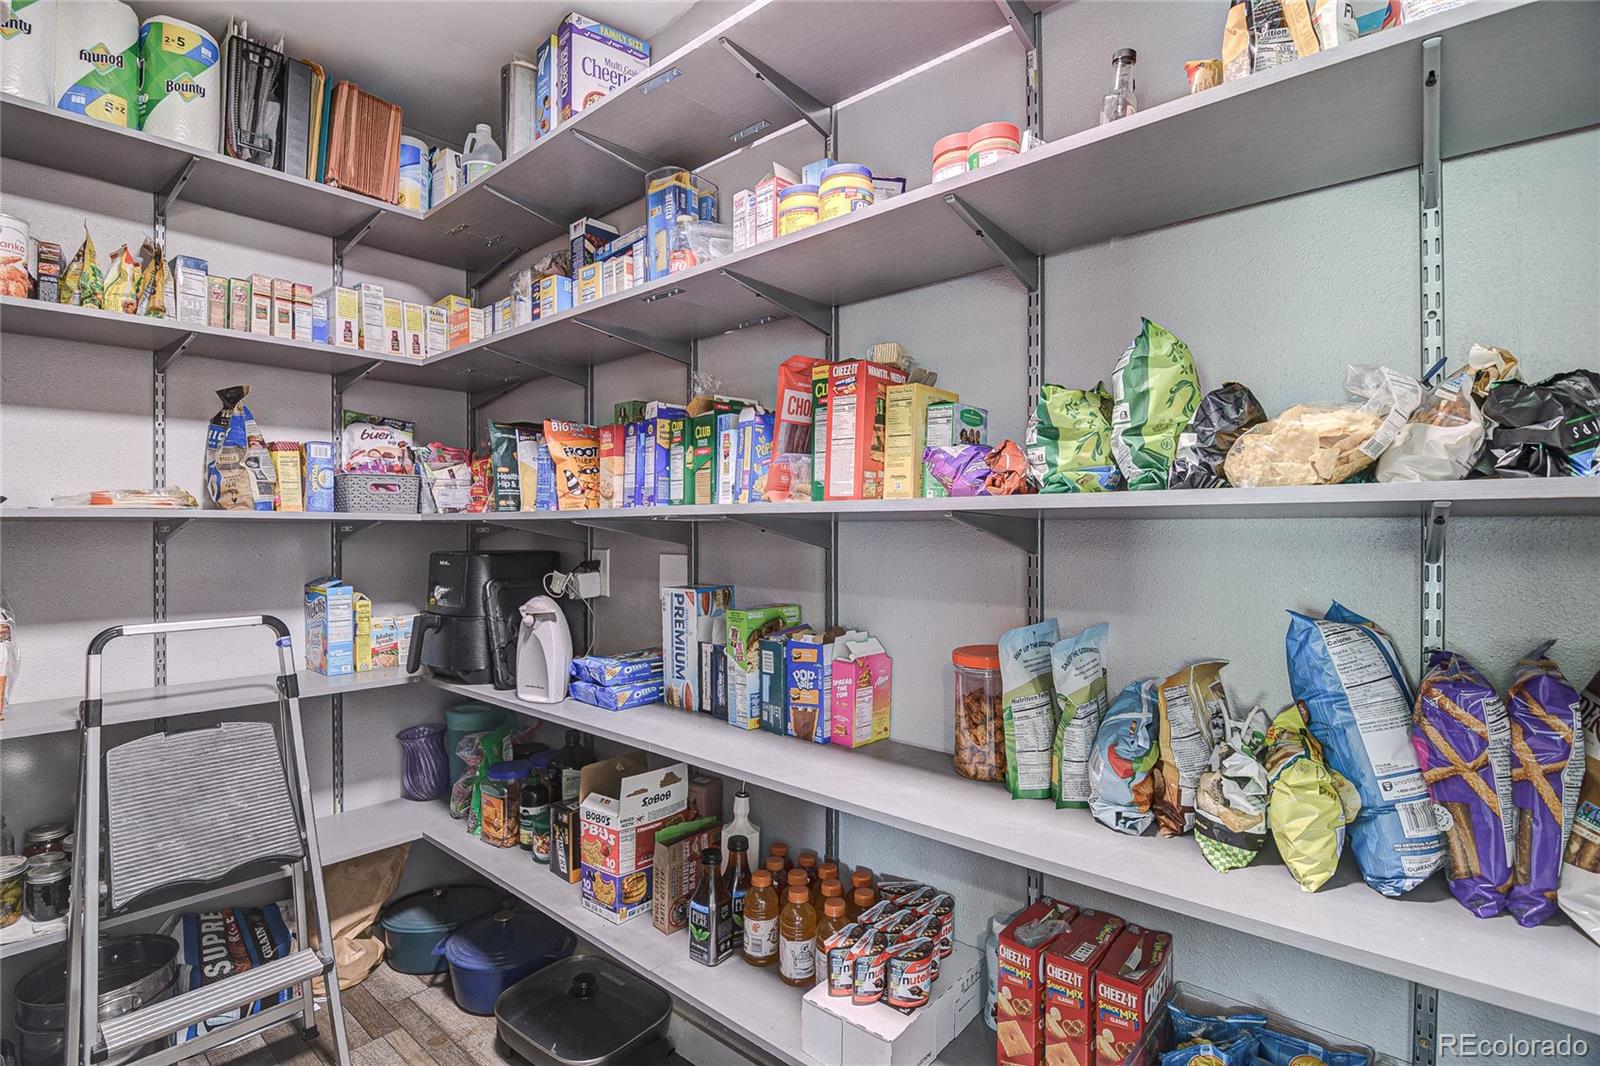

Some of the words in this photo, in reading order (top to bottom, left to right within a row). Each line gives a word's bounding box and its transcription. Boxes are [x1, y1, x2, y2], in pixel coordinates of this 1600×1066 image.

[600, 25, 626, 42] FAMILY
[628, 39, 643, 51] SIZE
[80, 49, 124, 68] Bounty
[582, 56, 632, 87] Cheeri
[604, 58, 623, 71] Multi
[623, 65, 640, 76] Grai
[166, 80, 206, 98] Bounty
[0, 240, 25, 253] anko
[833, 363, 858, 377] CHEEZ-IT
[787, 395, 812, 417] CHO
[552, 421, 569, 432] BIG
[671, 421, 683, 432] CLUB
[695, 426, 711, 439] CLUB
[564, 447, 599, 458] FROOT
[497, 473, 519, 481] Health
[497, 481, 510, 489] Hip
[674, 593, 687, 681] PREMIUM
[624, 662, 648, 674] OREO
[634, 686, 657, 699] OREO
[585, 811, 611, 826] BOBO'S
[606, 859, 616, 868] 10
[689, 860, 697, 890] BARS
[582, 879, 591, 889] 10
[255, 926, 273, 959] GRAIN
[998, 944, 1031, 969] CHEEZ-IT
[1007, 975, 1024, 985] CLASSIC
[1015, 968, 1032, 980] MIX
[1047, 963, 1083, 988] CHEEZ-IT
[1047, 979, 1067, 995] SNACK
[1066, 987, 1084, 1000] MIX
[1098, 982, 1138, 1009] CHEEZ-IT
[1057, 995, 1075, 1006] CLASSIC
[1099, 1000, 1120, 1015] SNACK
[1119, 1008, 1139, 1022] MIX
[1110, 1016, 1129, 1027] CLASSIC
